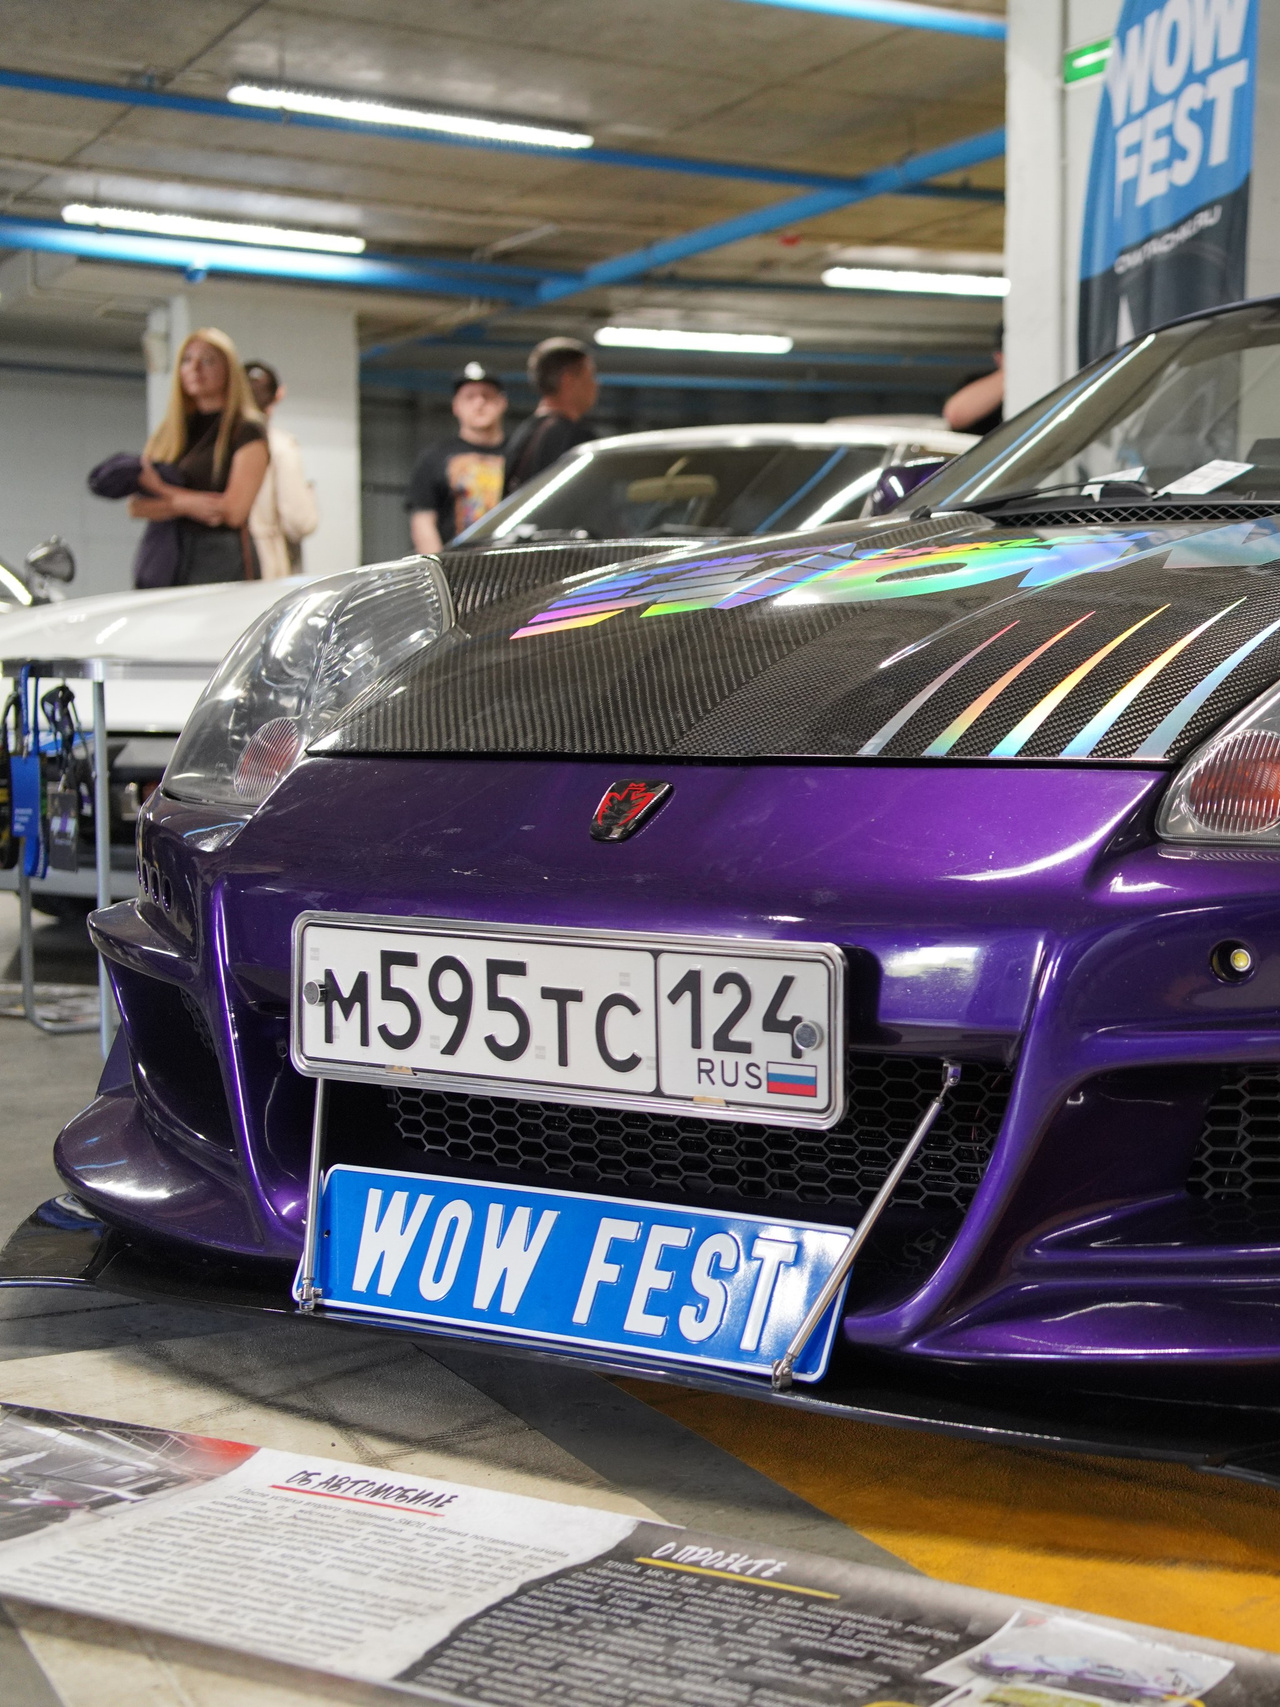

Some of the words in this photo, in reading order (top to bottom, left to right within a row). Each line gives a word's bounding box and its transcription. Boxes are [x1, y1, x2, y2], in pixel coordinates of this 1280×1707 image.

[1105, 0, 1249, 128] WOW
[1115, 59, 1249, 207] FEST
[667, 968, 803, 1059] 124
[697, 1057, 762, 1090] RUS
[352, 1188, 561, 1314] WOW
[572, 1218, 797, 1352] FEST
[285, 1470, 321, 1486] ОБ
[311, 1475, 458, 1509] АВТОМОБИЛЕ
[652, 1541, 677, 1558] О
[672, 1544, 787, 1578] ПРОЕКТЕ
